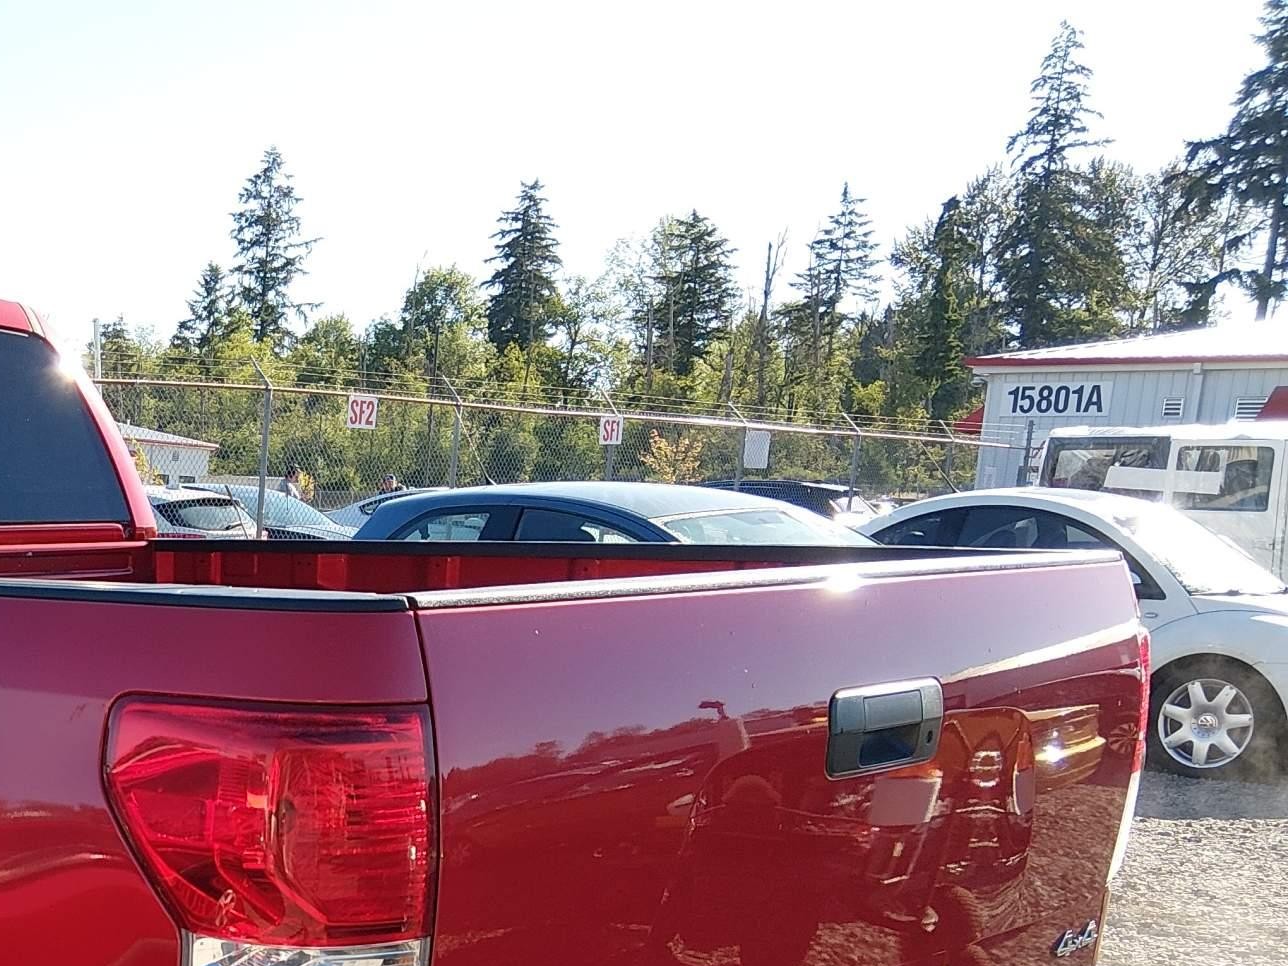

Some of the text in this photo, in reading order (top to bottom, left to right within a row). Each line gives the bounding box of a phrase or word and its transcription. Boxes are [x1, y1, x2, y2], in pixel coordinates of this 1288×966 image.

[349, 399, 375, 426] SF2
[1006, 383, 1104, 415] 15801A
[602, 419, 621, 442] SF1
